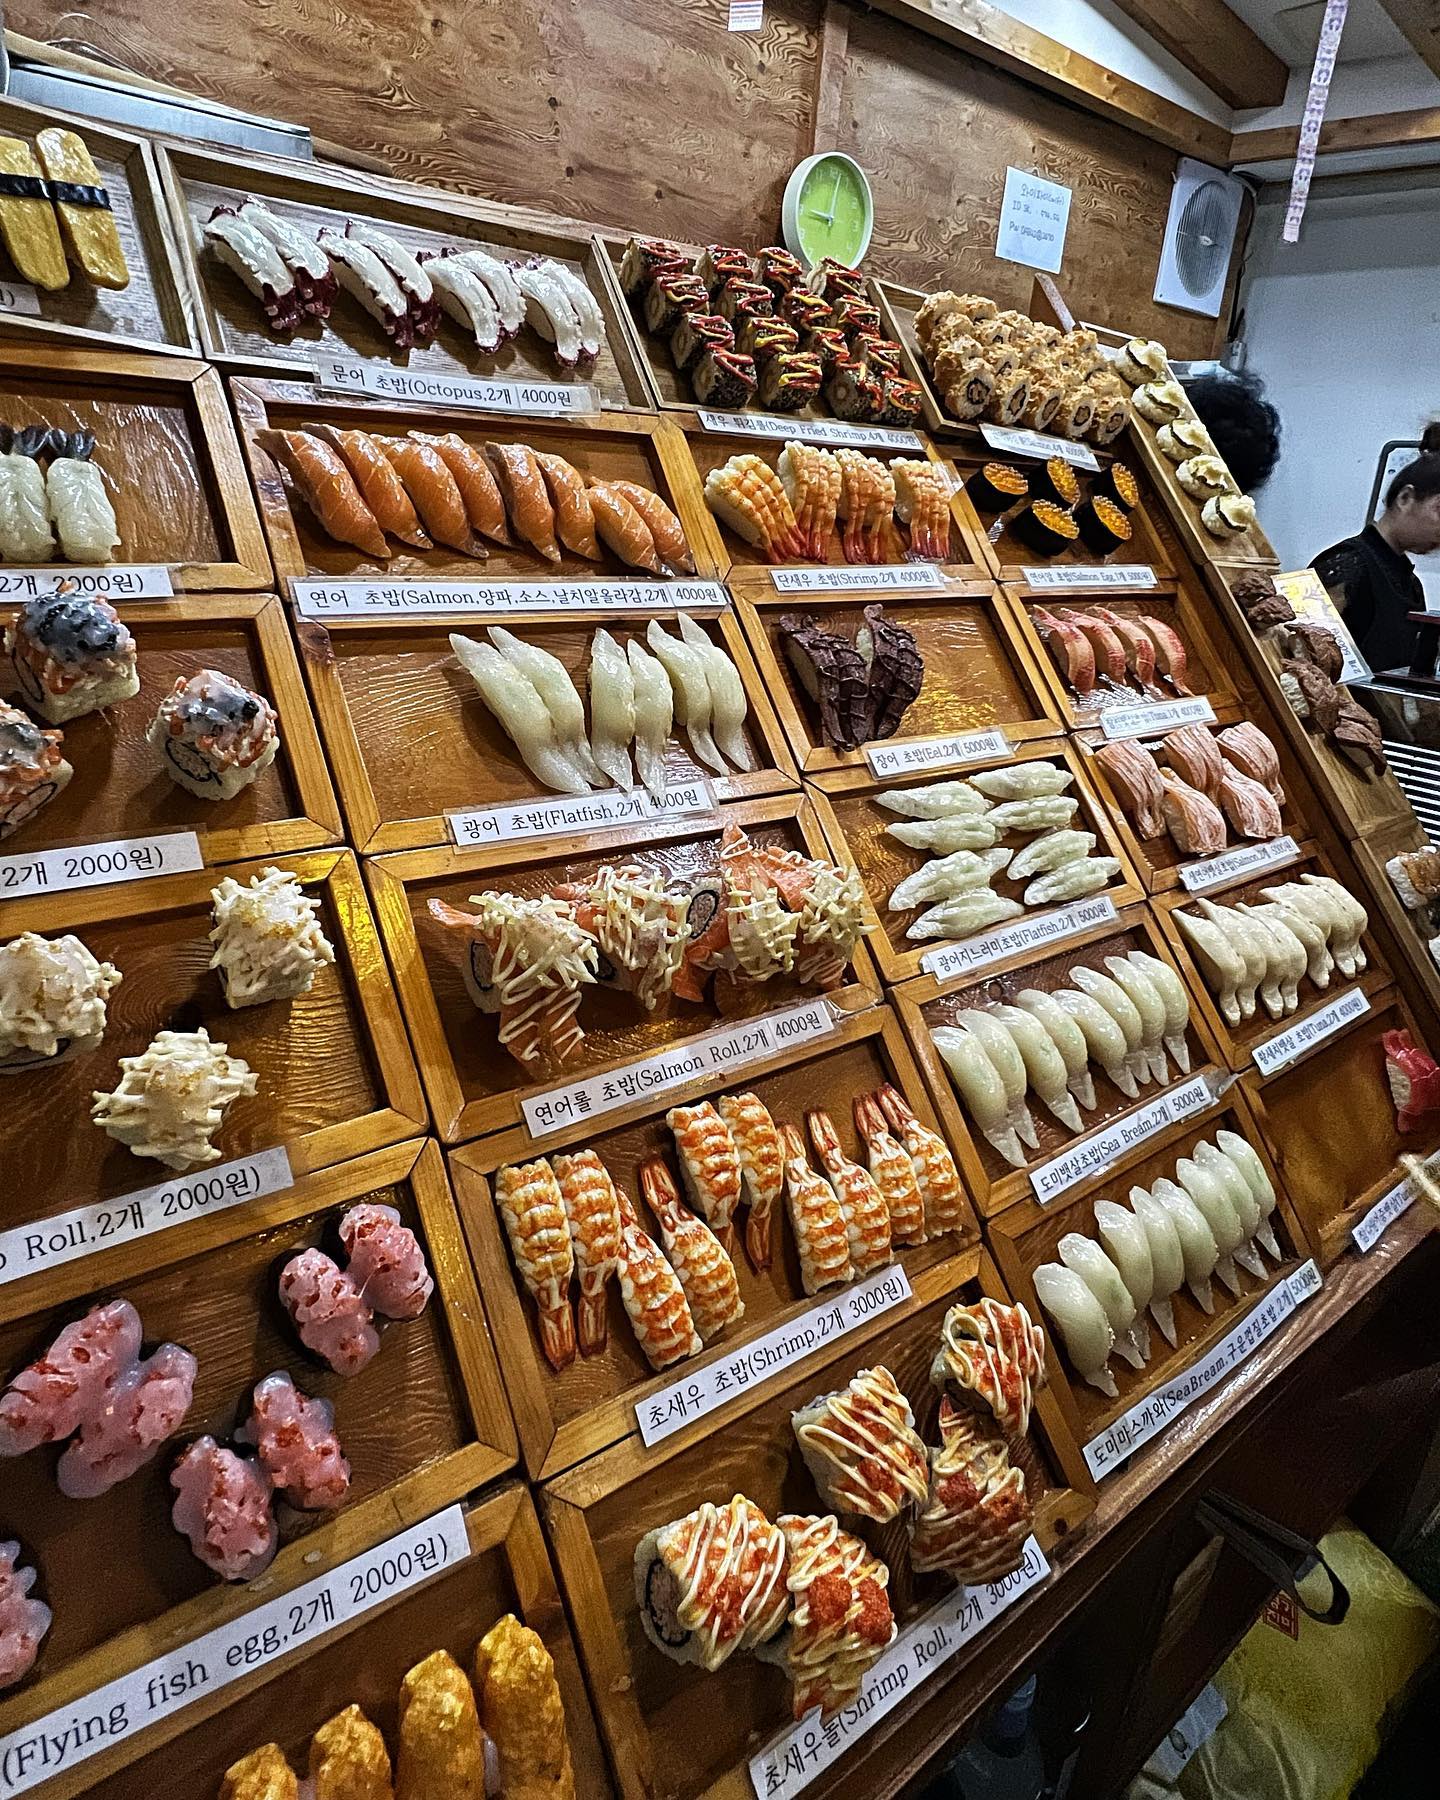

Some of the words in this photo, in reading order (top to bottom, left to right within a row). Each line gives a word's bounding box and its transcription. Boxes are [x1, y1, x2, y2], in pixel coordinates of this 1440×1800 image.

[331, 364, 366, 387] 문어
[521, 388, 572, 407] 4000원
[800, 424, 828, 438] Fried
[53, 573, 144, 593] 2000원)
[777, 573, 812, 588] 단새우
[900, 569, 935, 584] 4000원)
[309, 589, 348, 608] 연어
[675, 588, 719, 604] 4000원
[875, 752, 900, 770] 장어
[462, 816, 500, 839] 광어
[650, 789, 700, 809] 4000원
[2, 860, 49, 888] 2개
[64, 846, 163, 878] 2000원)
[1078, 902, 1110, 924] 5000원
[534, 1089, 592, 1127] 연어롤
[602, 1053, 705, 1103] 초밥(Salmon
[775, 1009, 822, 1039] 4000원
[1172, 1085, 1206, 1113] 5000원
[24, 1201, 145, 1262] Roll,2개
[160, 1166, 261, 1217] 2000원)
[649, 1383, 706, 1431] 초새우
[849, 1275, 905, 1320] 3000원)
[956, 1595, 984, 1632] 2개
[2, 1702, 129, 1787] (Flying
[145, 1660, 208, 1711] fish
[226, 1588, 336, 1668] egg,2개
[350, 1532, 449, 1605] 2000원)
